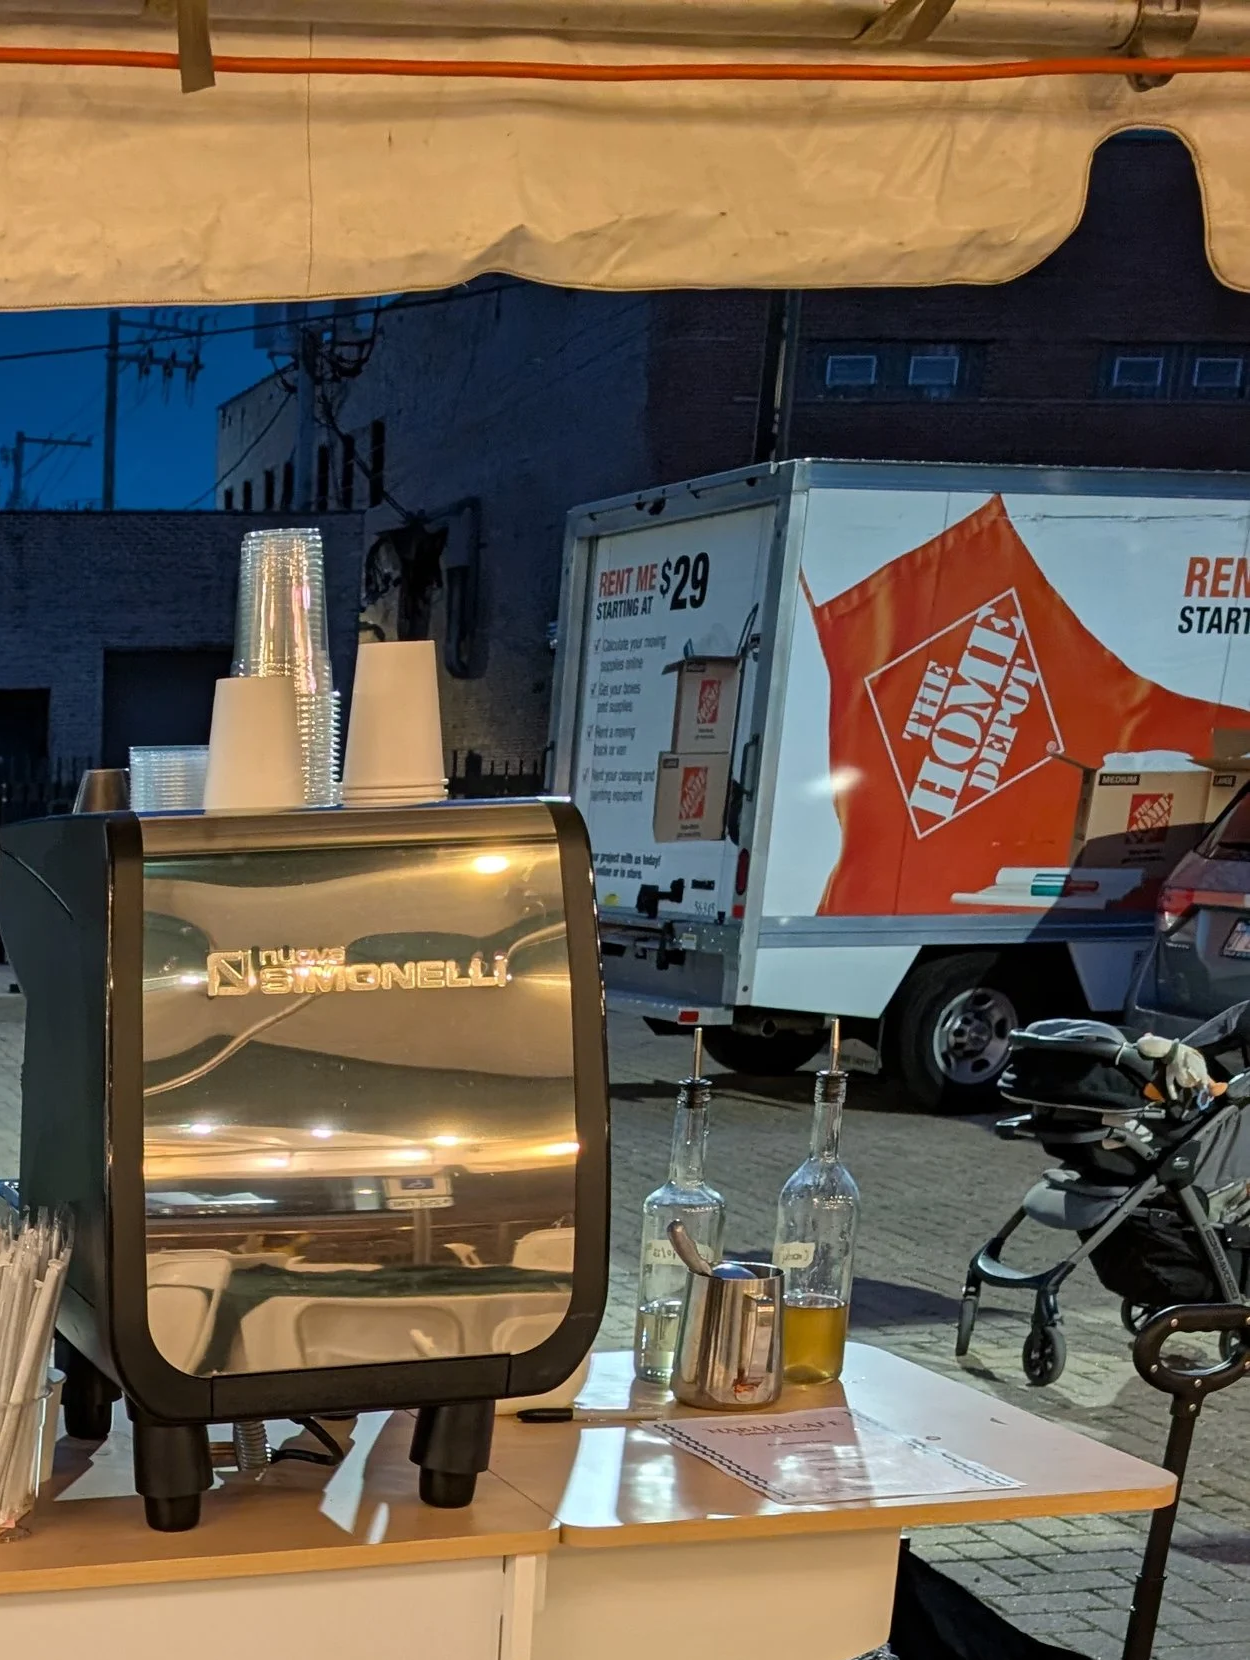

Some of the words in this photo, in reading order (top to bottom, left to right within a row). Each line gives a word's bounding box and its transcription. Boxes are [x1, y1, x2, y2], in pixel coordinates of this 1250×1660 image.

[596, 600, 639, 620] STARTING
[641, 596, 653, 615] AT
[599, 568, 633, 597] RENT
[636, 564, 657, 592] ME
[660, 552, 709, 611] $29
[902, 660, 953, 741] THE
[908, 605, 1024, 821] HOME
[968, 657, 1039, 792] DEPOT
[1101, 776, 1138, 785] MEDIUM
